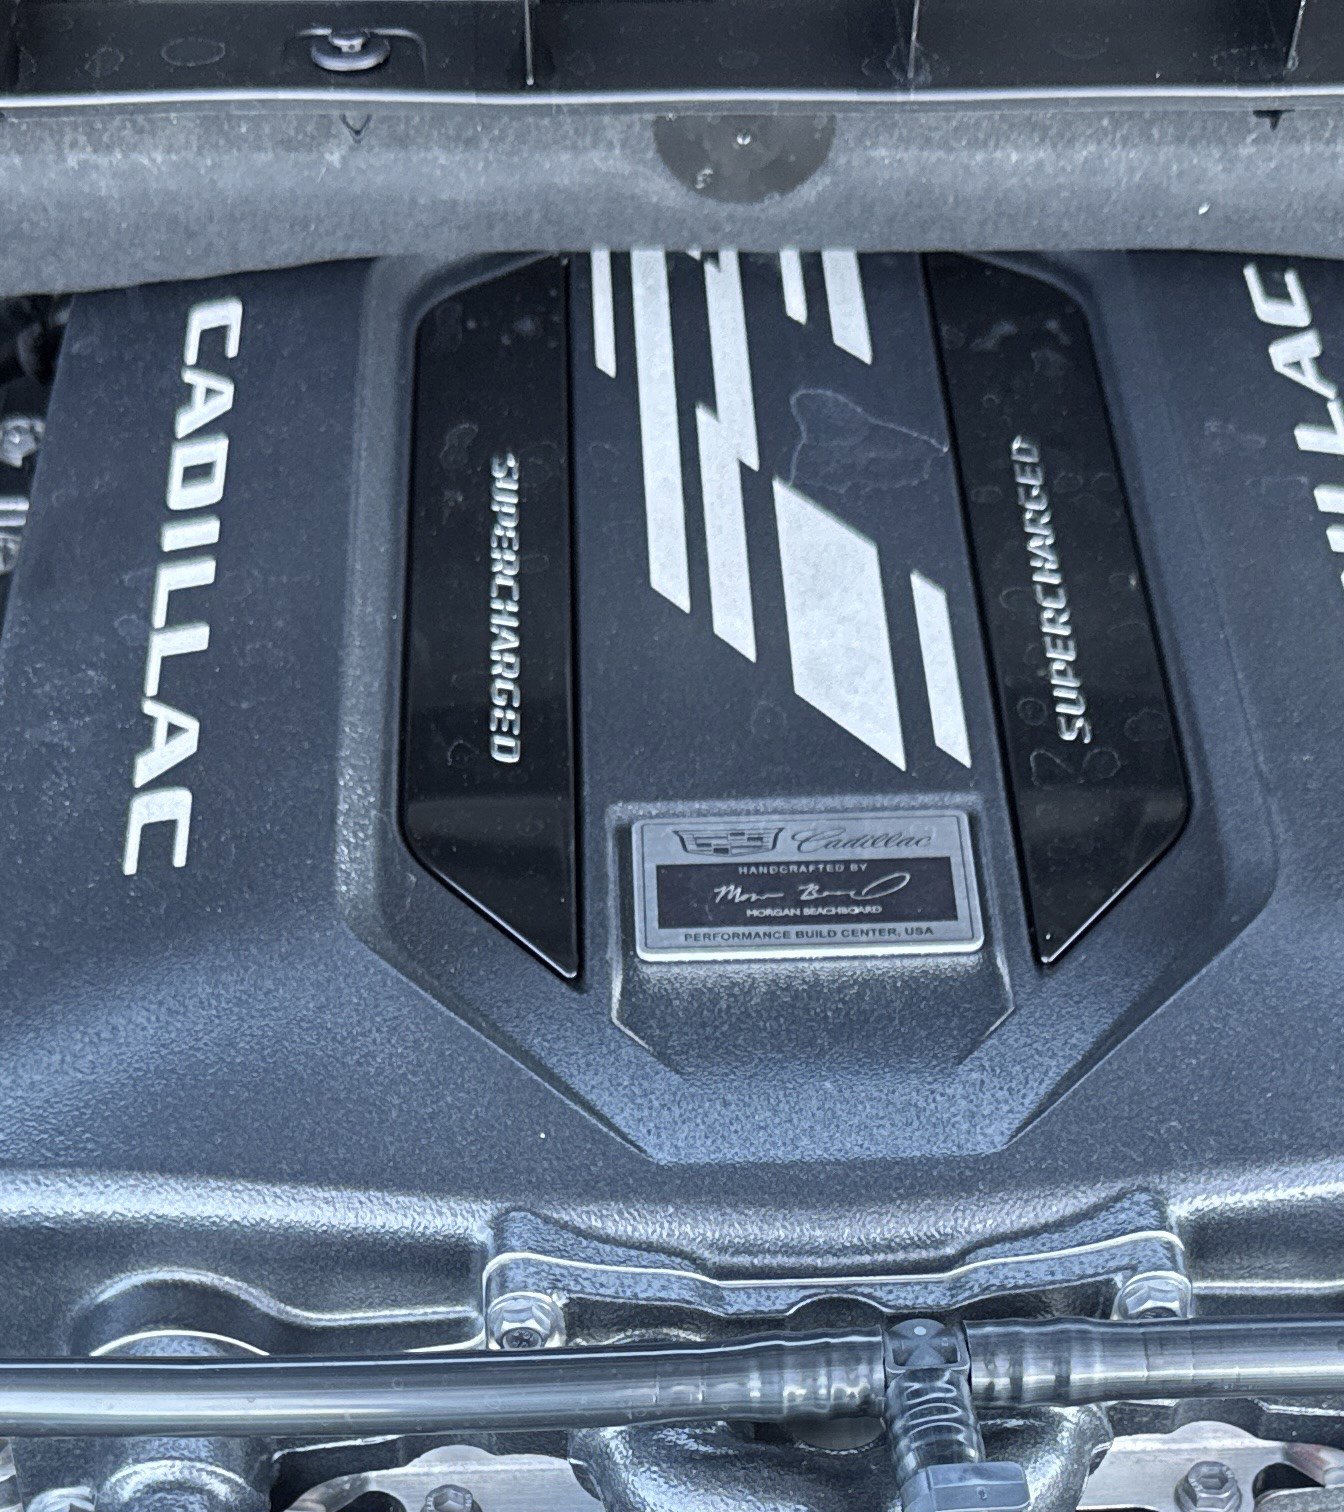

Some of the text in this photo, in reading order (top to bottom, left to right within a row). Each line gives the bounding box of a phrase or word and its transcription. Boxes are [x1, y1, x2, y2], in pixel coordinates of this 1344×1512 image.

[122, 296, 242, 875] CADILLAC
[1011, 434, 1091, 744] SUPERCHARGED
[490, 452, 521, 763] SUPERCHARGED
[791, 828, 931, 853] Cadillac
[738, 862, 868, 875] HANDCRAFTED BY
[746, 905, 882, 917] MORGAN BEACHBOARD
[684, 930, 791, 942] PERFORMANCE
[795, 929, 837, 939] BUILD
[904, 926, 935, 936] USA
